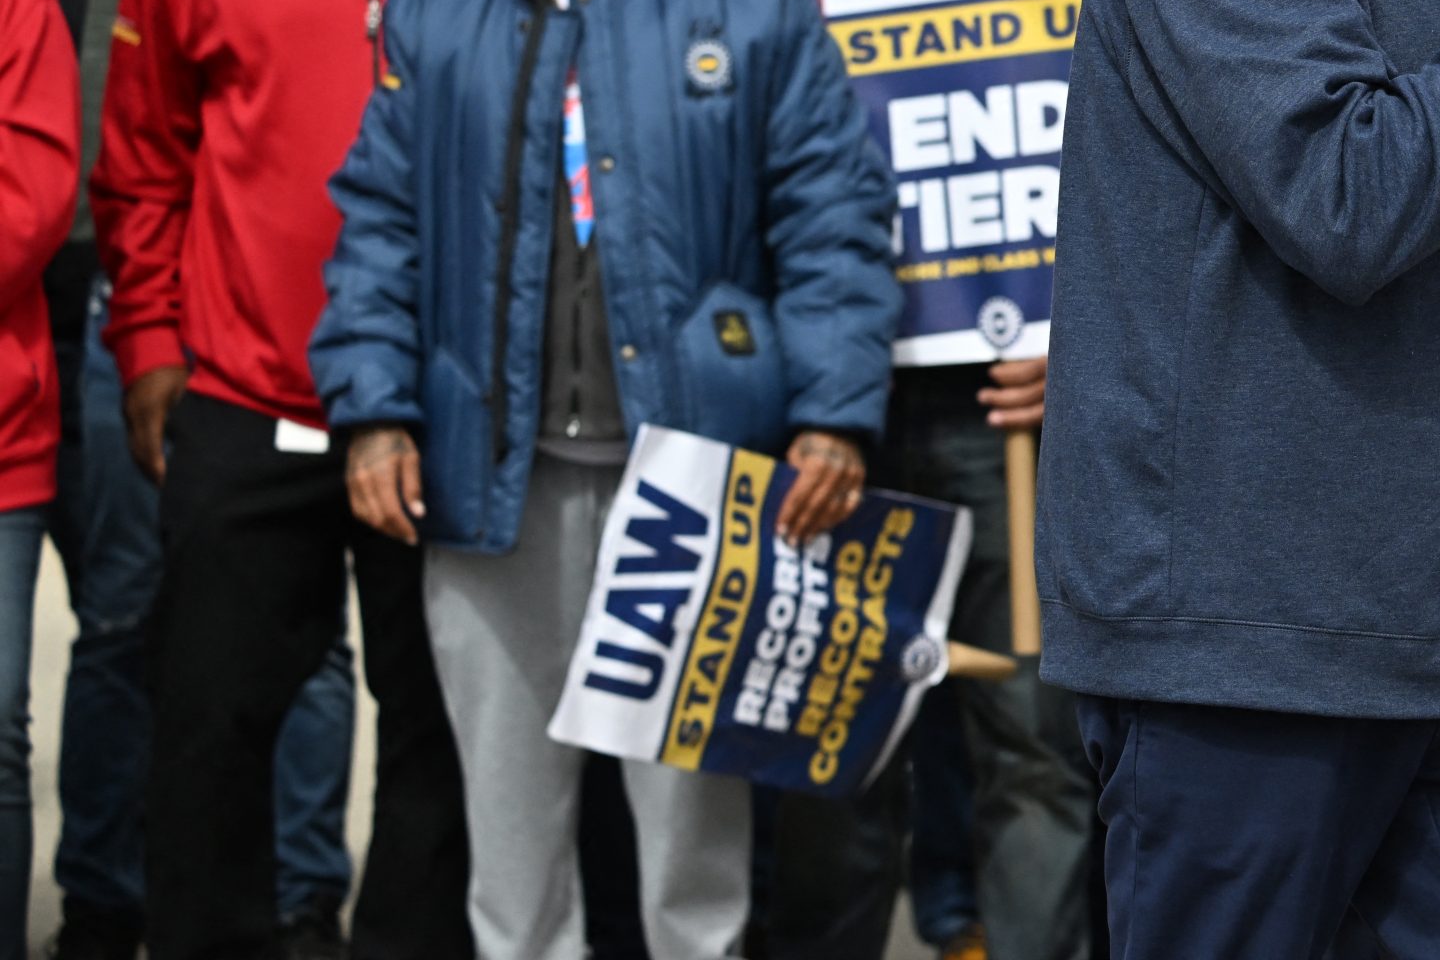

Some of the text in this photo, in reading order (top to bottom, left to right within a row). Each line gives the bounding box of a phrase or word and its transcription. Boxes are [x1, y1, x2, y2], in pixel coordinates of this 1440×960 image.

[848, 3, 1079, 65] STAND U
[888, 79, 1069, 173] END
[892, 165, 1061, 254] IER
[583, 478, 709, 701] UAW
[677, 472, 756, 748] STAND UP
[763, 534, 832, 732] PROFITS
[796, 540, 865, 736] RECORD
[809, 507, 914, 784] CONTRACTS
